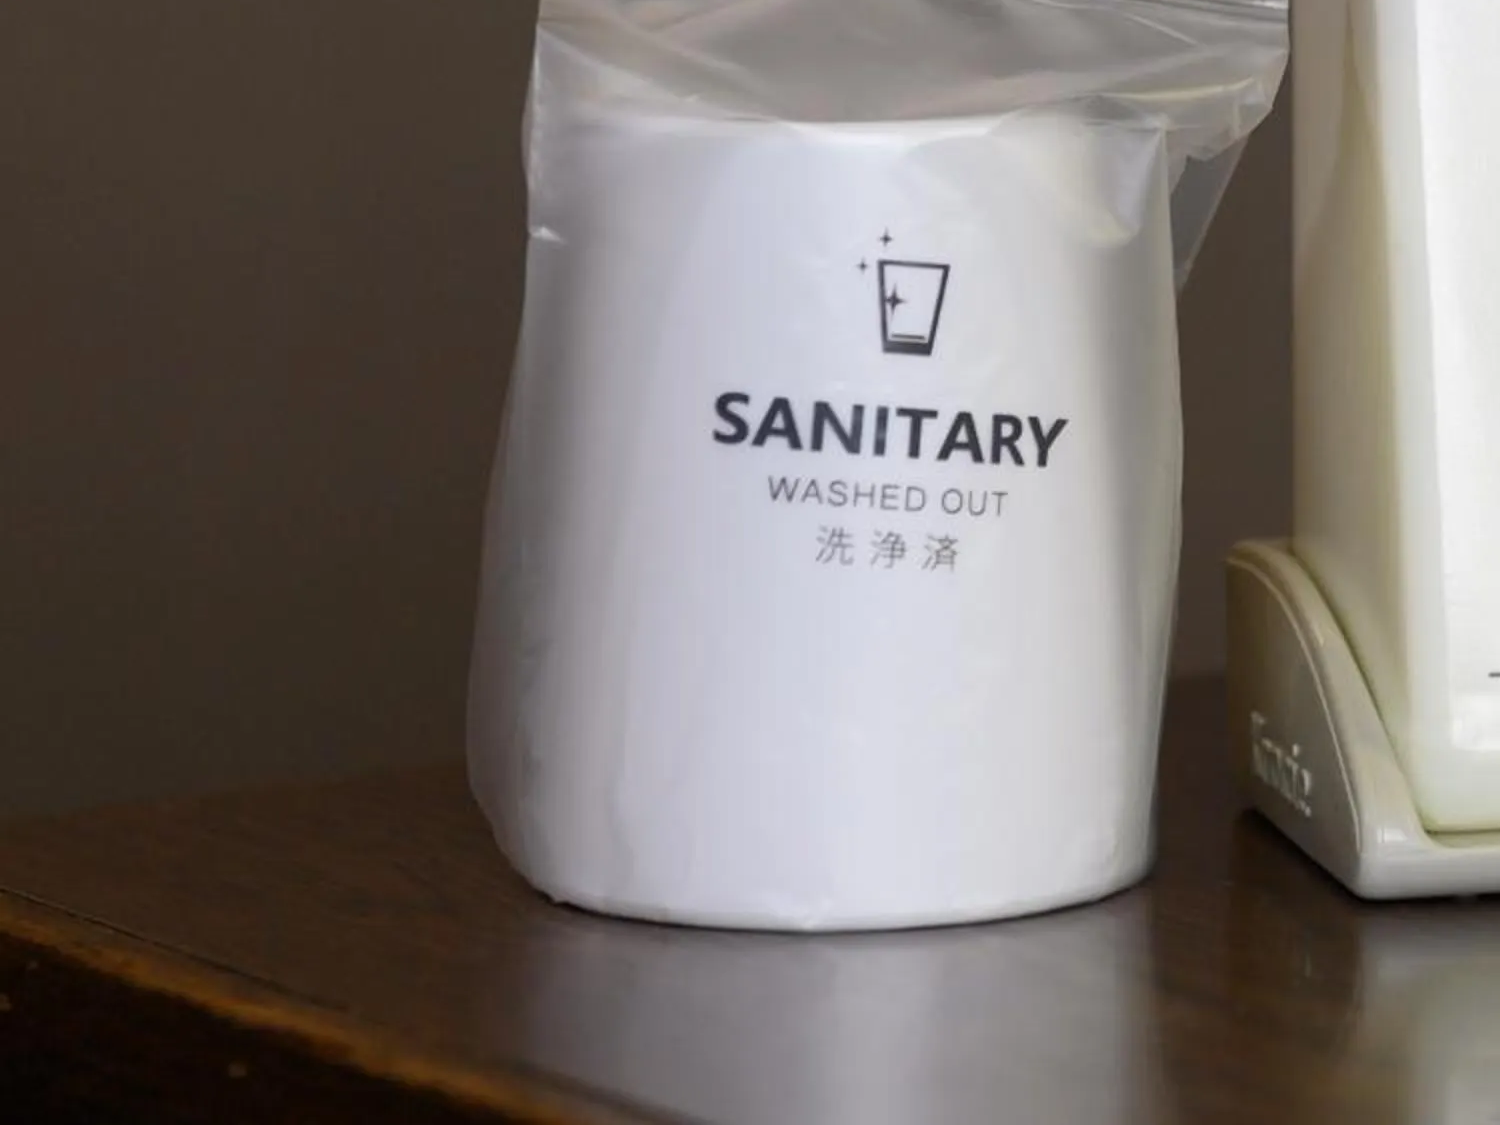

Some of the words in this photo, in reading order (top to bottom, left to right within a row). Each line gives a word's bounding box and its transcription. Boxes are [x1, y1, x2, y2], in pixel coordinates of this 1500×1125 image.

[711, 390, 1070, 469] SANITARY
[766, 474, 928, 513] WASHED
[939, 486, 1010, 518] OUT
[813, 524, 961, 573] 洗浄済
